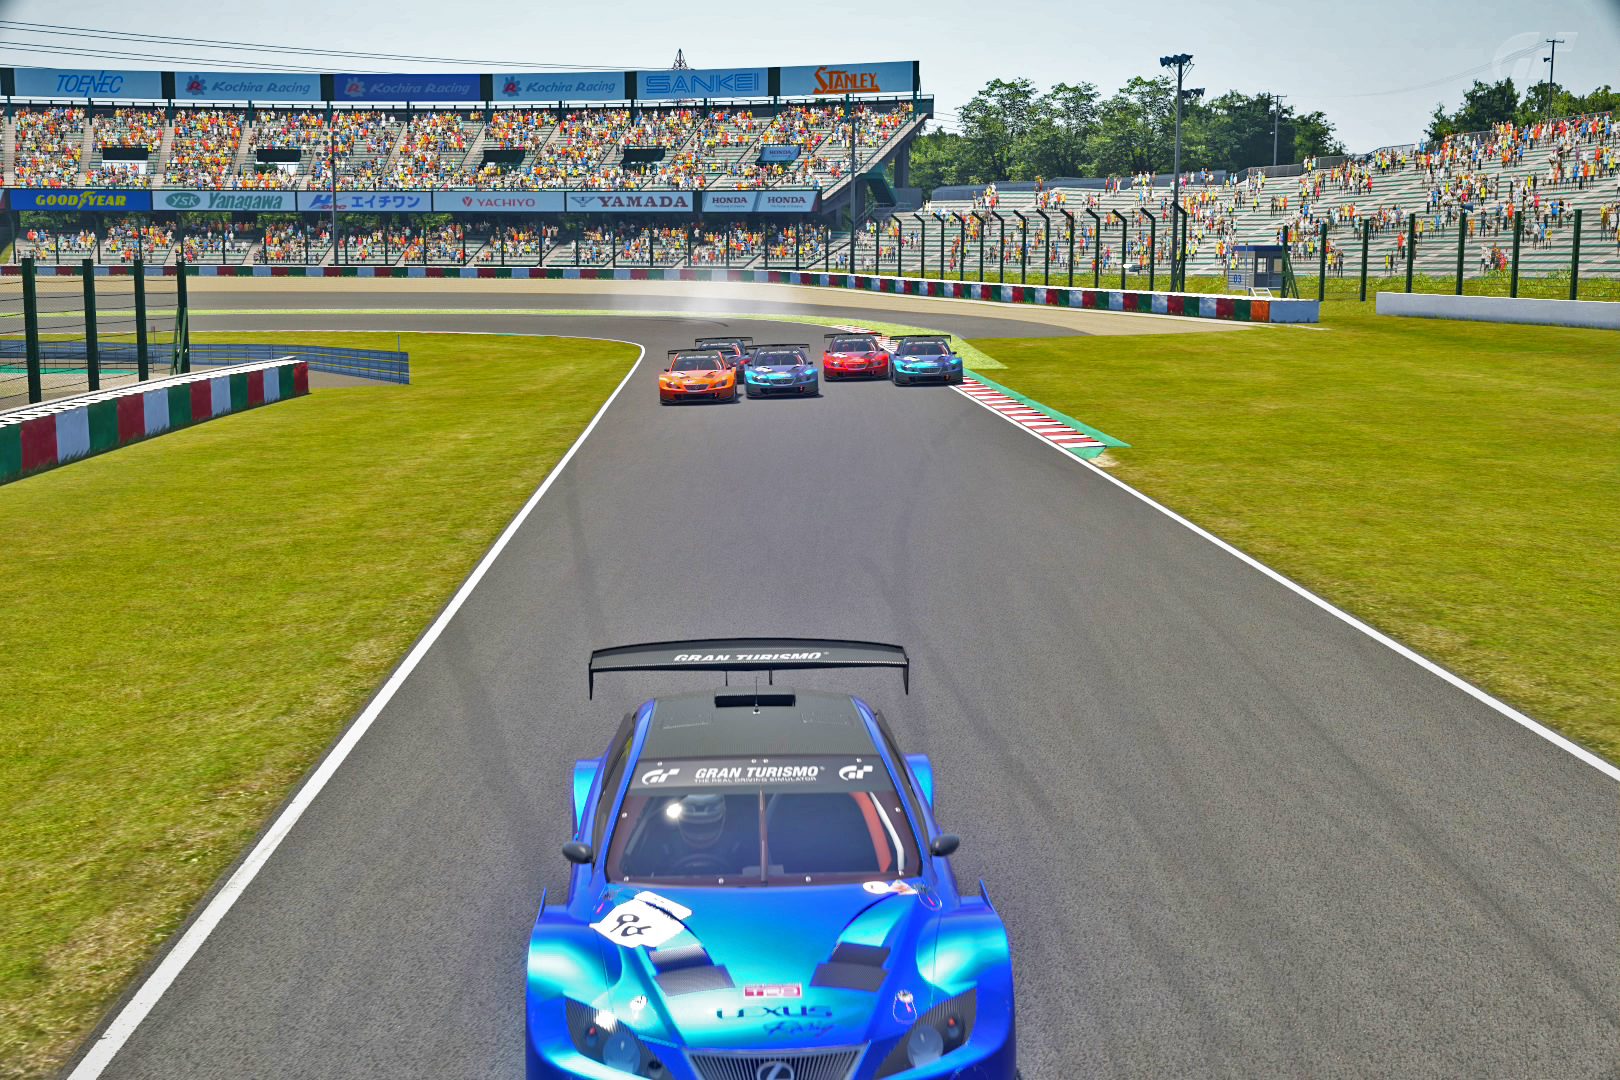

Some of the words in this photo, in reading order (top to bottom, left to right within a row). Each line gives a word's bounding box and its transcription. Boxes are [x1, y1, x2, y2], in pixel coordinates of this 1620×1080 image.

[56, 70, 124, 97] TOENEC
[525, 81, 573, 93] Kochira
[575, 80, 616, 94] Racing
[645, 71, 760, 94] SANKEI
[812, 66, 881, 95] STANLEY
[211, 81, 264, 93] Kochira
[266, 81, 311, 95] Racing
[369, 82, 423, 94] Kochira
[424, 82, 470, 96] Racing
[35, 191, 127, 209] GOODYEAR
[171, 195, 199, 206] YSK
[208, 191, 283, 210] Yanagawa
[351, 195, 420, 208] エイチワン
[477, 198, 536, 207] YACHIYO
[597, 195, 689, 208] YAMADA
[712, 196, 748, 204] HONDA
[767, 196, 807, 204] HONDA
[673, 653, 731, 662] GRAN
[736, 651, 822, 661] TURISMO
[695, 766, 742, 779] GRAN
[747, 765, 819, 778] TURISMO
